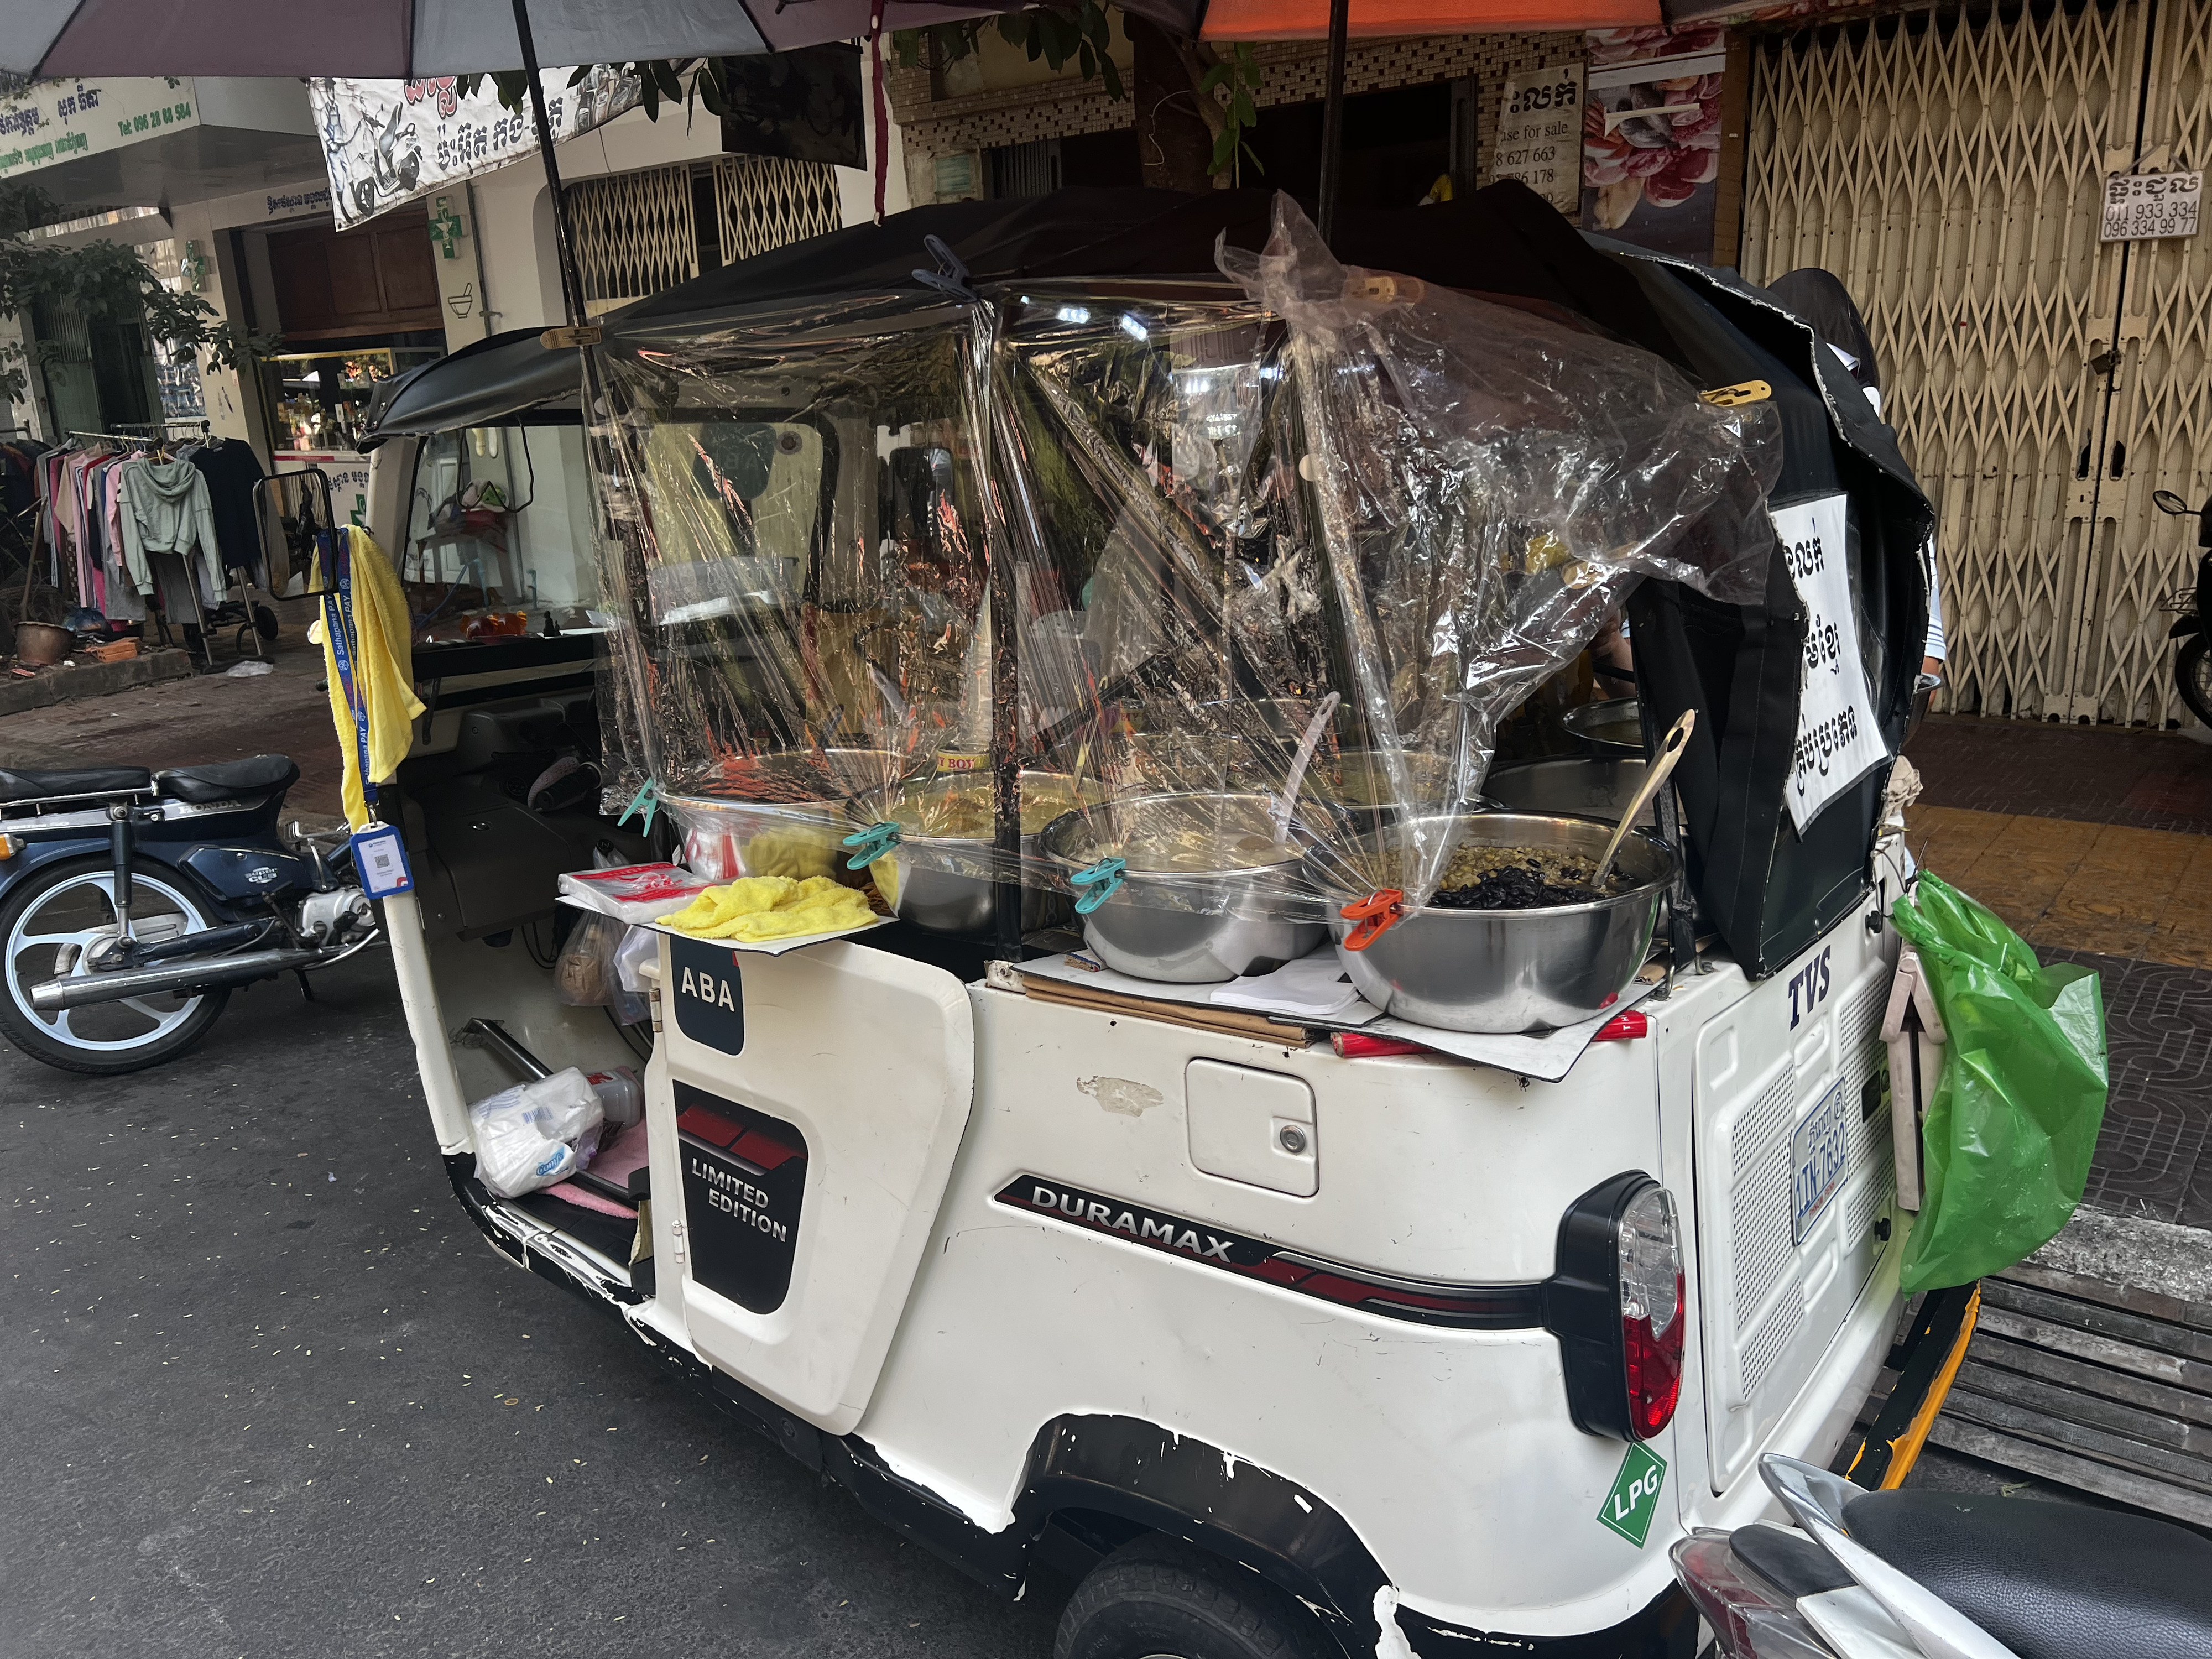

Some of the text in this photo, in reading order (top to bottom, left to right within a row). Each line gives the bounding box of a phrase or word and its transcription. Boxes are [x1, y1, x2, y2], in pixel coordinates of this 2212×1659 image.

[133, 113, 149, 132] 096
[1524, 124, 1542, 139] for
[1545, 121, 1569, 137] sale
[1507, 150, 1529, 166] 627
[1533, 145, 1556, 162] 663
[1533, 168, 1554, 184] 178
[2105, 200, 2197, 222] 011 933 334
[2104, 216, 2197, 238] 096 334 99 77
[343, 595, 352, 612] PAY
[332, 613, 345, 656] Sathapana
[178, 800, 242, 815] HONDA
[681, 967, 735, 1012] ABA
[1788, 945, 1831, 1032] TVS
[691, 1157, 770, 1209] LIMITED
[708, 1187, 787, 1243] EDITION
[1808, 1180, 1835, 1220] PHNOM PENH
[1031, 1185, 1235, 1264] DURAMAX
[1614, 1464, 1658, 1521] LPG
